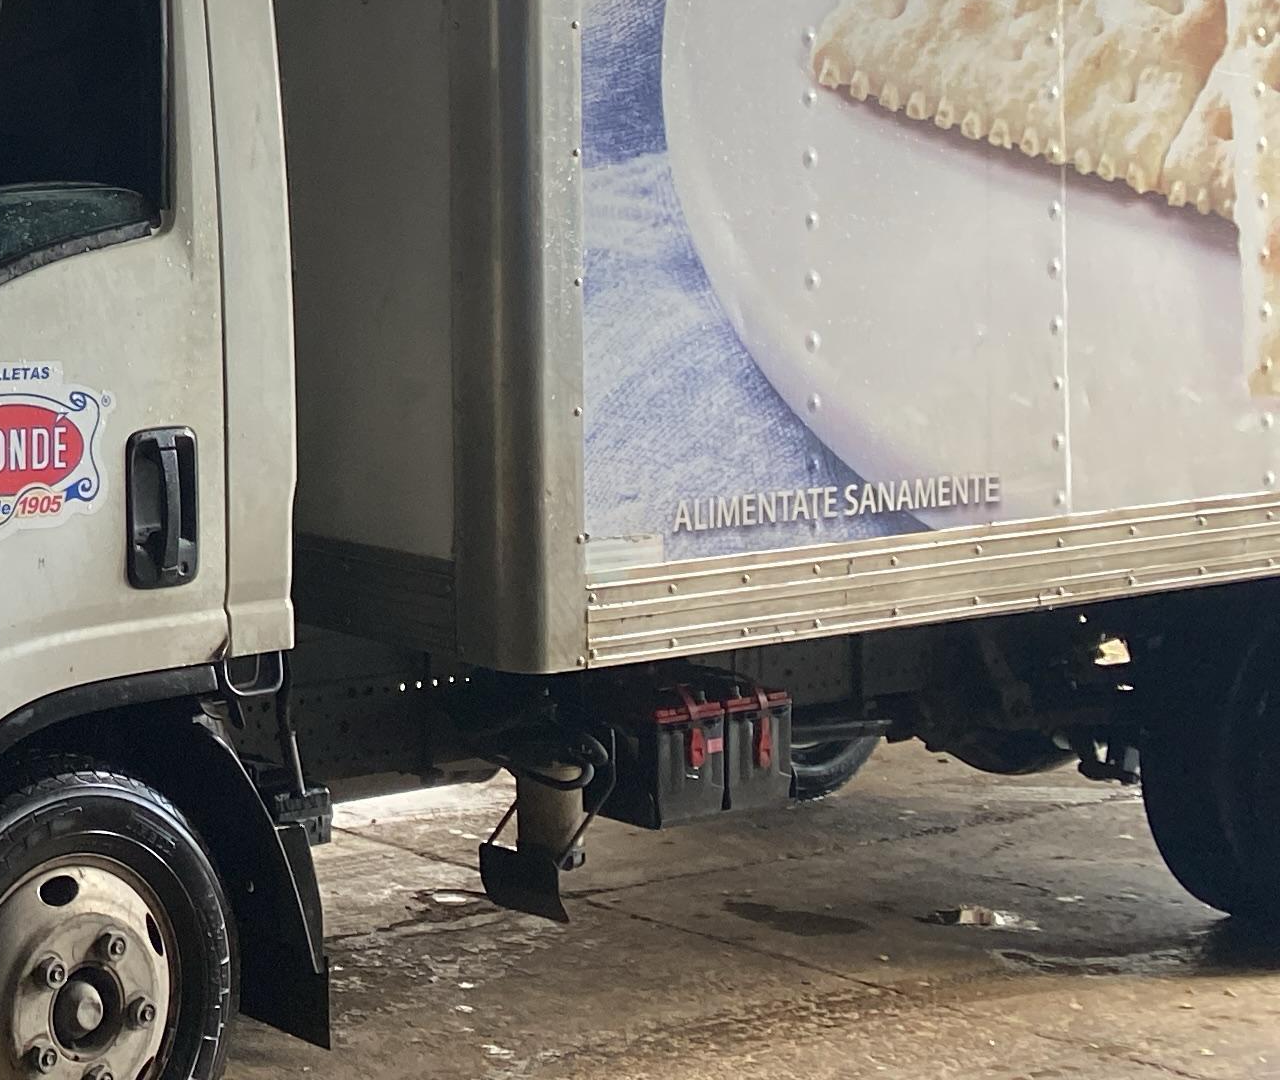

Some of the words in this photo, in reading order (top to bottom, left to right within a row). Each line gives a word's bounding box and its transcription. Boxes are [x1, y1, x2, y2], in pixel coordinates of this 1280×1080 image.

[18, 494, 64, 515] 1905
[672, 485, 839, 533] ALIMENTATE
[843, 472, 1001, 516] SANAMENTE
